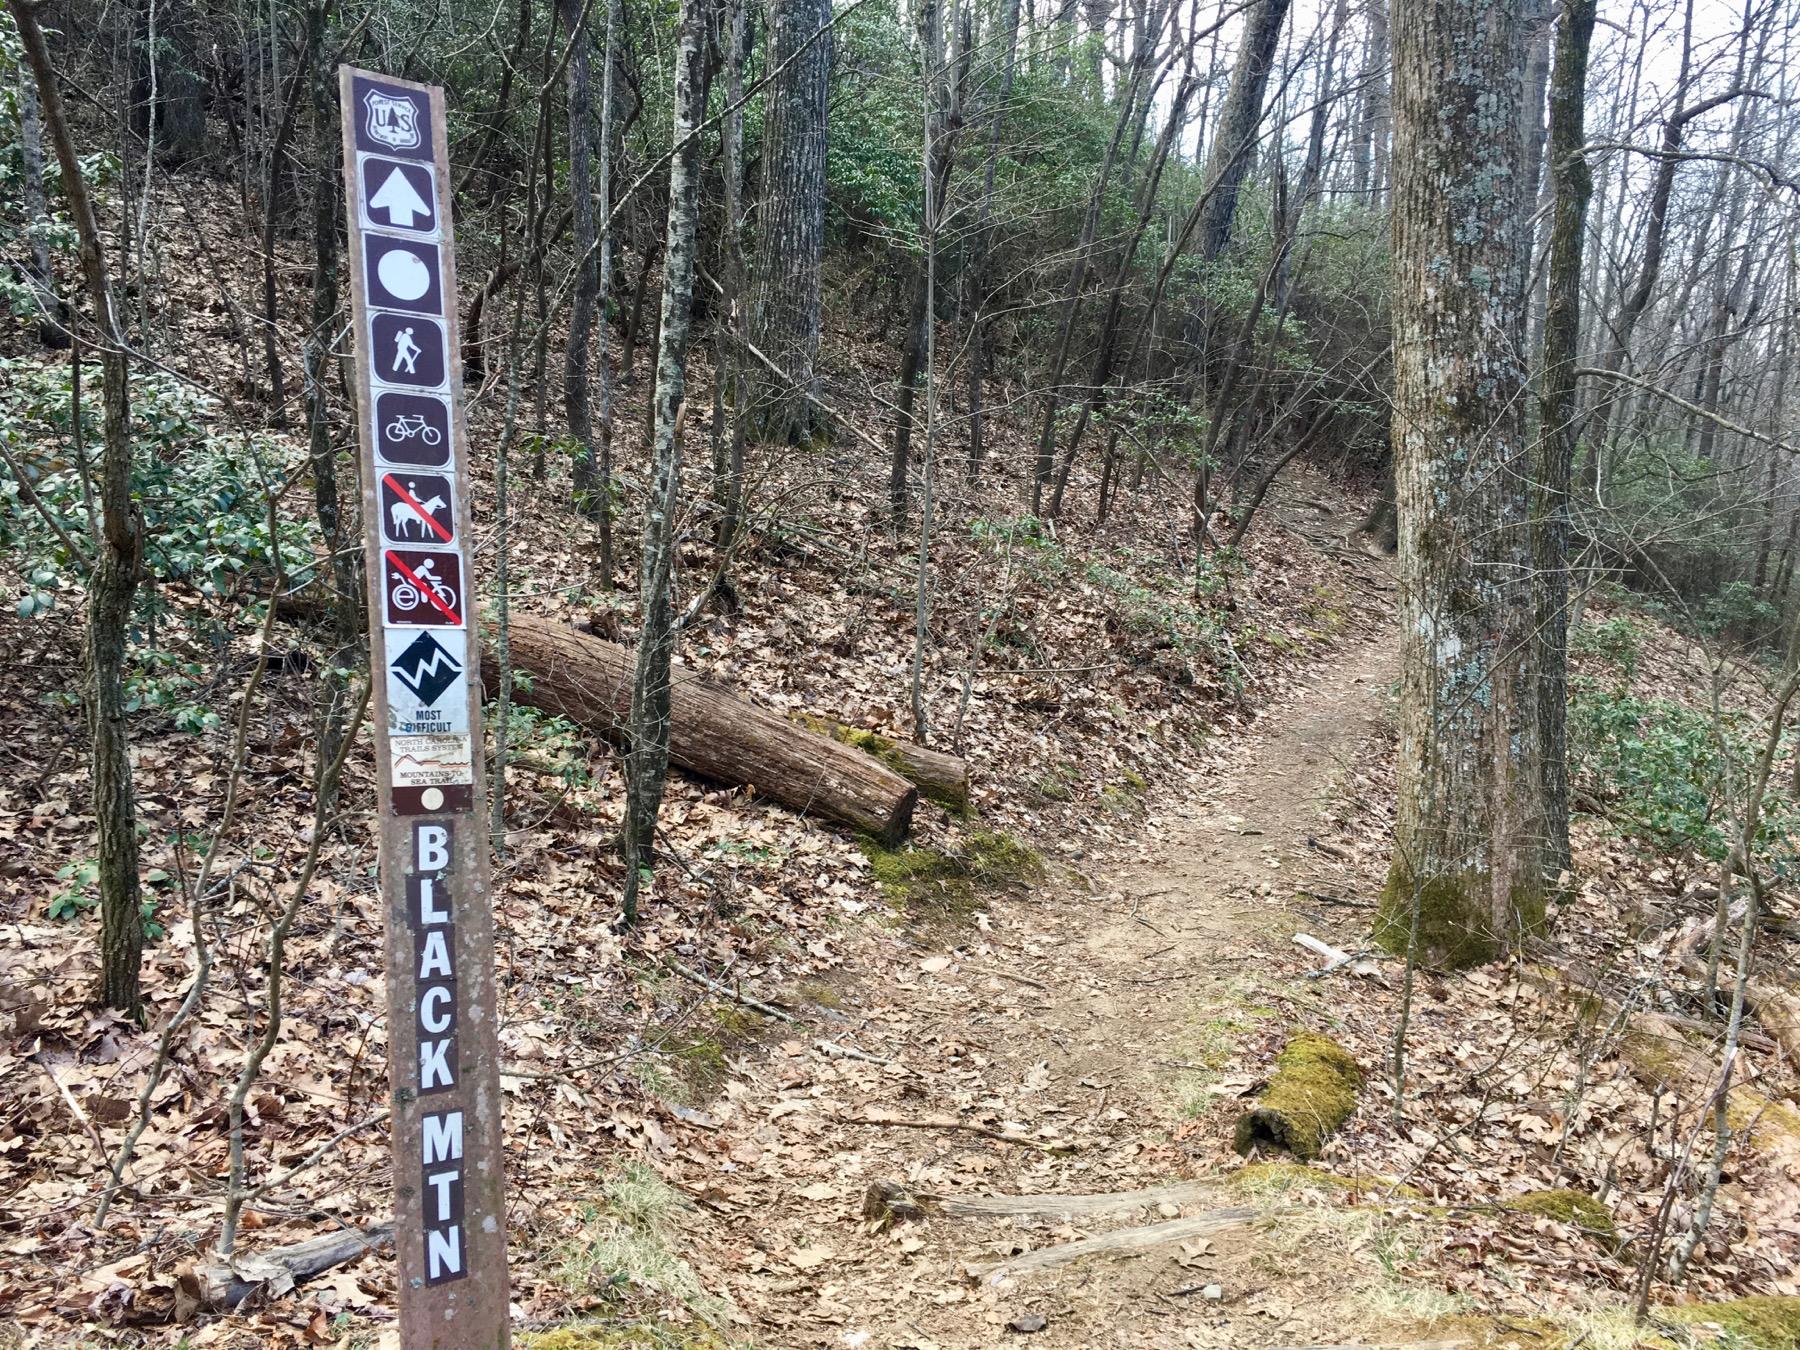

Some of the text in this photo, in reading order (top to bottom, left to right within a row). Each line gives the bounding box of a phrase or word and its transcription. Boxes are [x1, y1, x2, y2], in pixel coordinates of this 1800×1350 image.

[416, 710, 442, 721] MOST
[405, 722, 452, 733] DIFFICULT
[430, 777, 454, 785] TRAIL
[418, 825, 463, 1279] BLACK MTN
